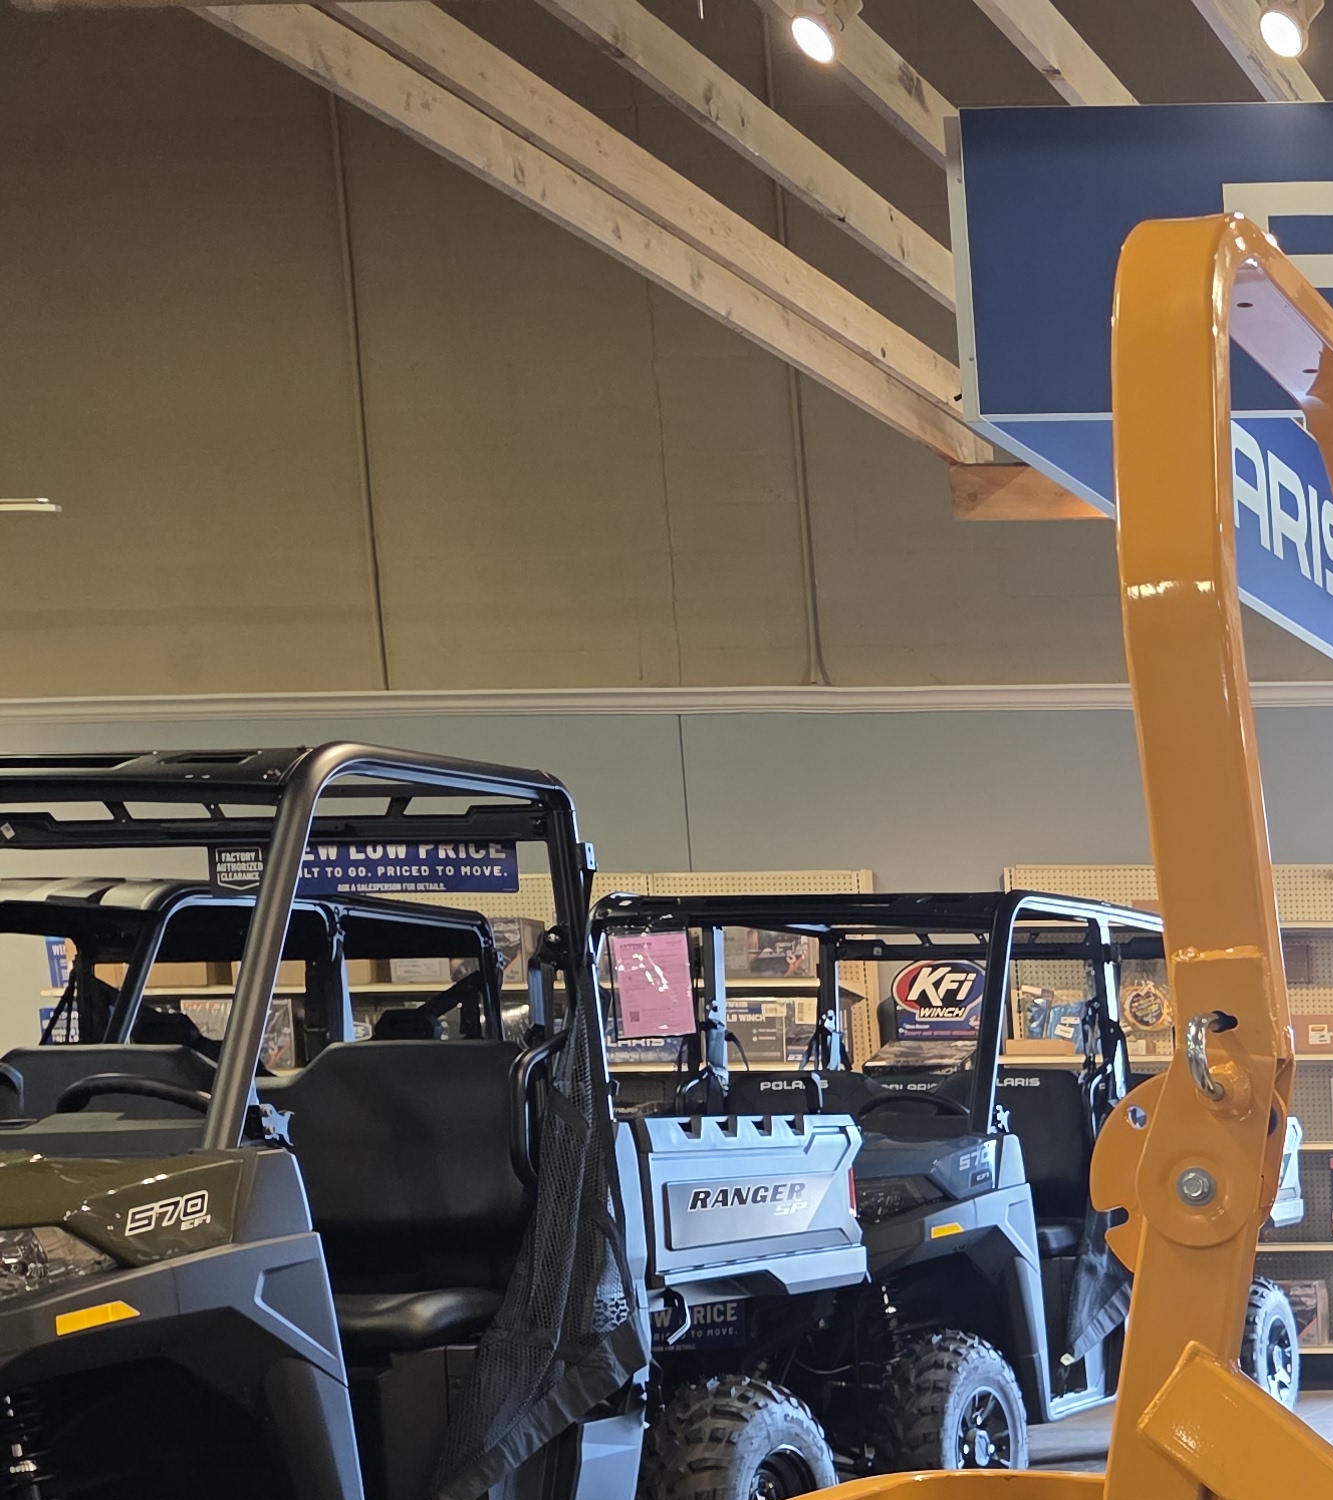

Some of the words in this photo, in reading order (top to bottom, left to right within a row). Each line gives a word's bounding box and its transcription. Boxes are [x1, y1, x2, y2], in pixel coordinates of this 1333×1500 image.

[222, 851, 256, 862] FACTORY
[216, 862, 263, 872] AUTHORIZED
[326, 867, 342, 877] TO
[348, 866, 372, 877] GO.
[377, 866, 429, 877] PRICED
[436, 866, 453, 876] TO
[461, 865, 508, 877] MOVE.
[920, 1007, 965, 1017] WINCH
[760, 1080, 828, 1091] POLAS
[996, 1077, 1040, 1087] LARIS
[687, 1182, 806, 1212] RANGER
[125, 1190, 208, 1236] 570
[774, 1201, 808, 1217] SP
[692, 1303, 737, 1325] RICE
[707, 1327, 738, 1337] MOVE.
